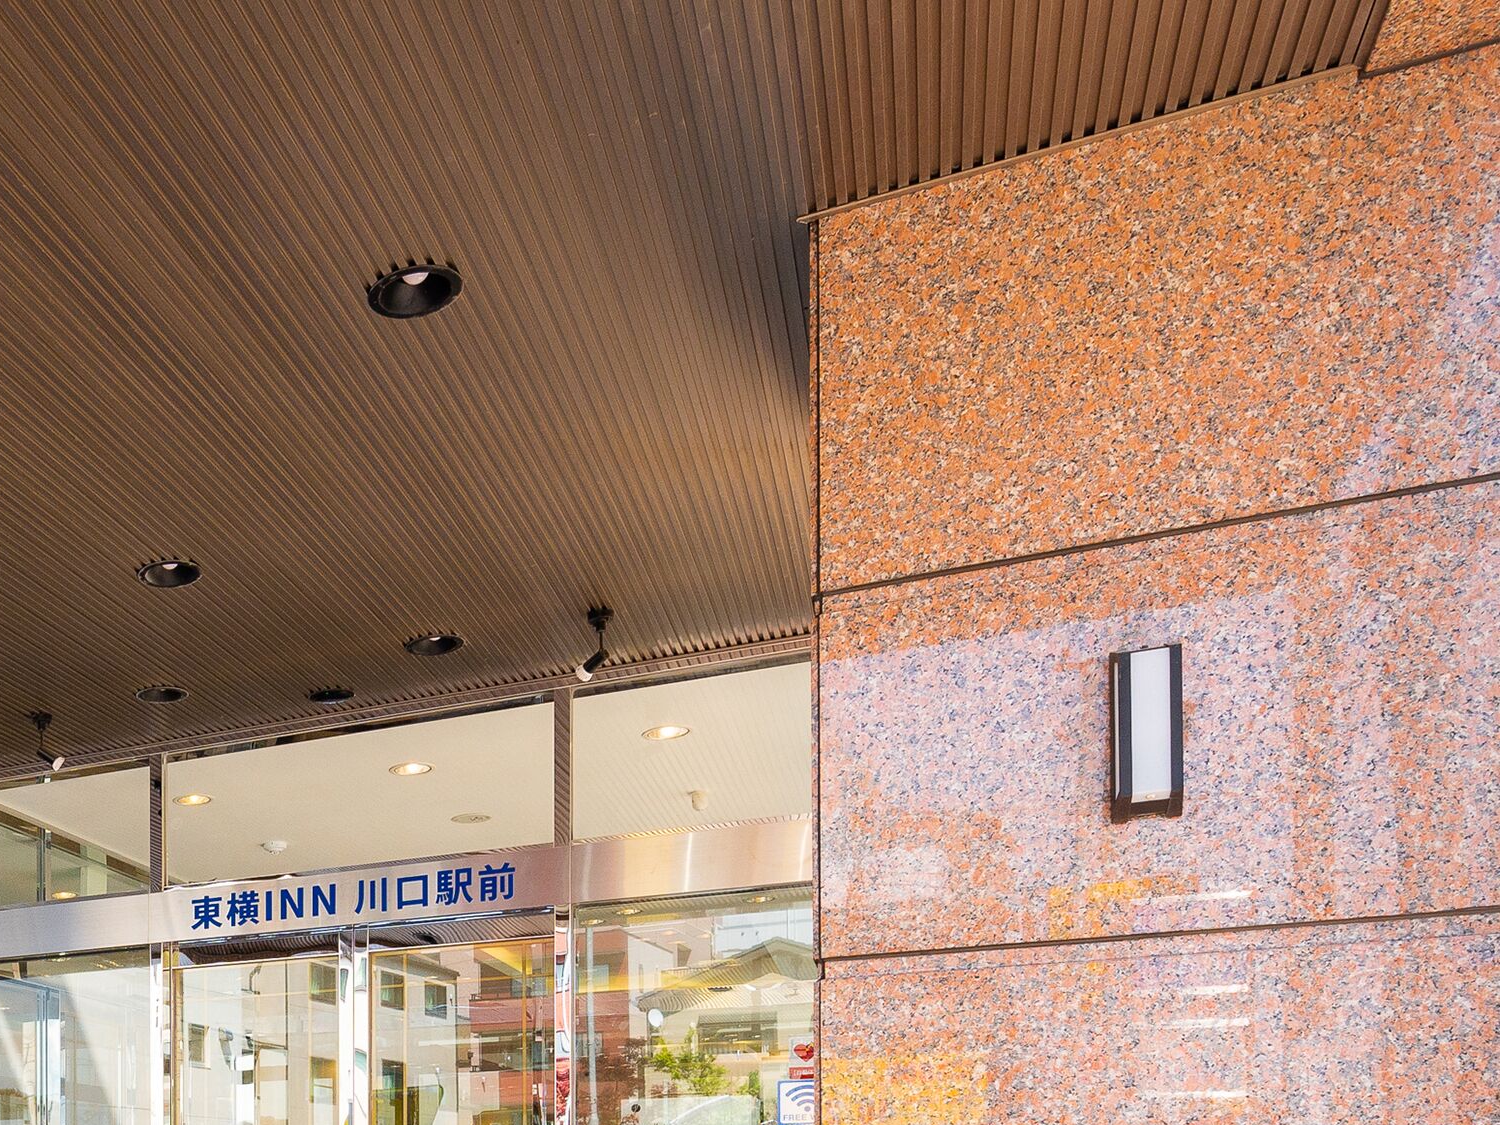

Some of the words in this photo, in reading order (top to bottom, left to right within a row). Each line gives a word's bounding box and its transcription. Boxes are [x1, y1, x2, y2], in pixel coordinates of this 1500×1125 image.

[191, 883, 337, 931] 東横INN
[354, 862, 516, 915] 川口駅前
